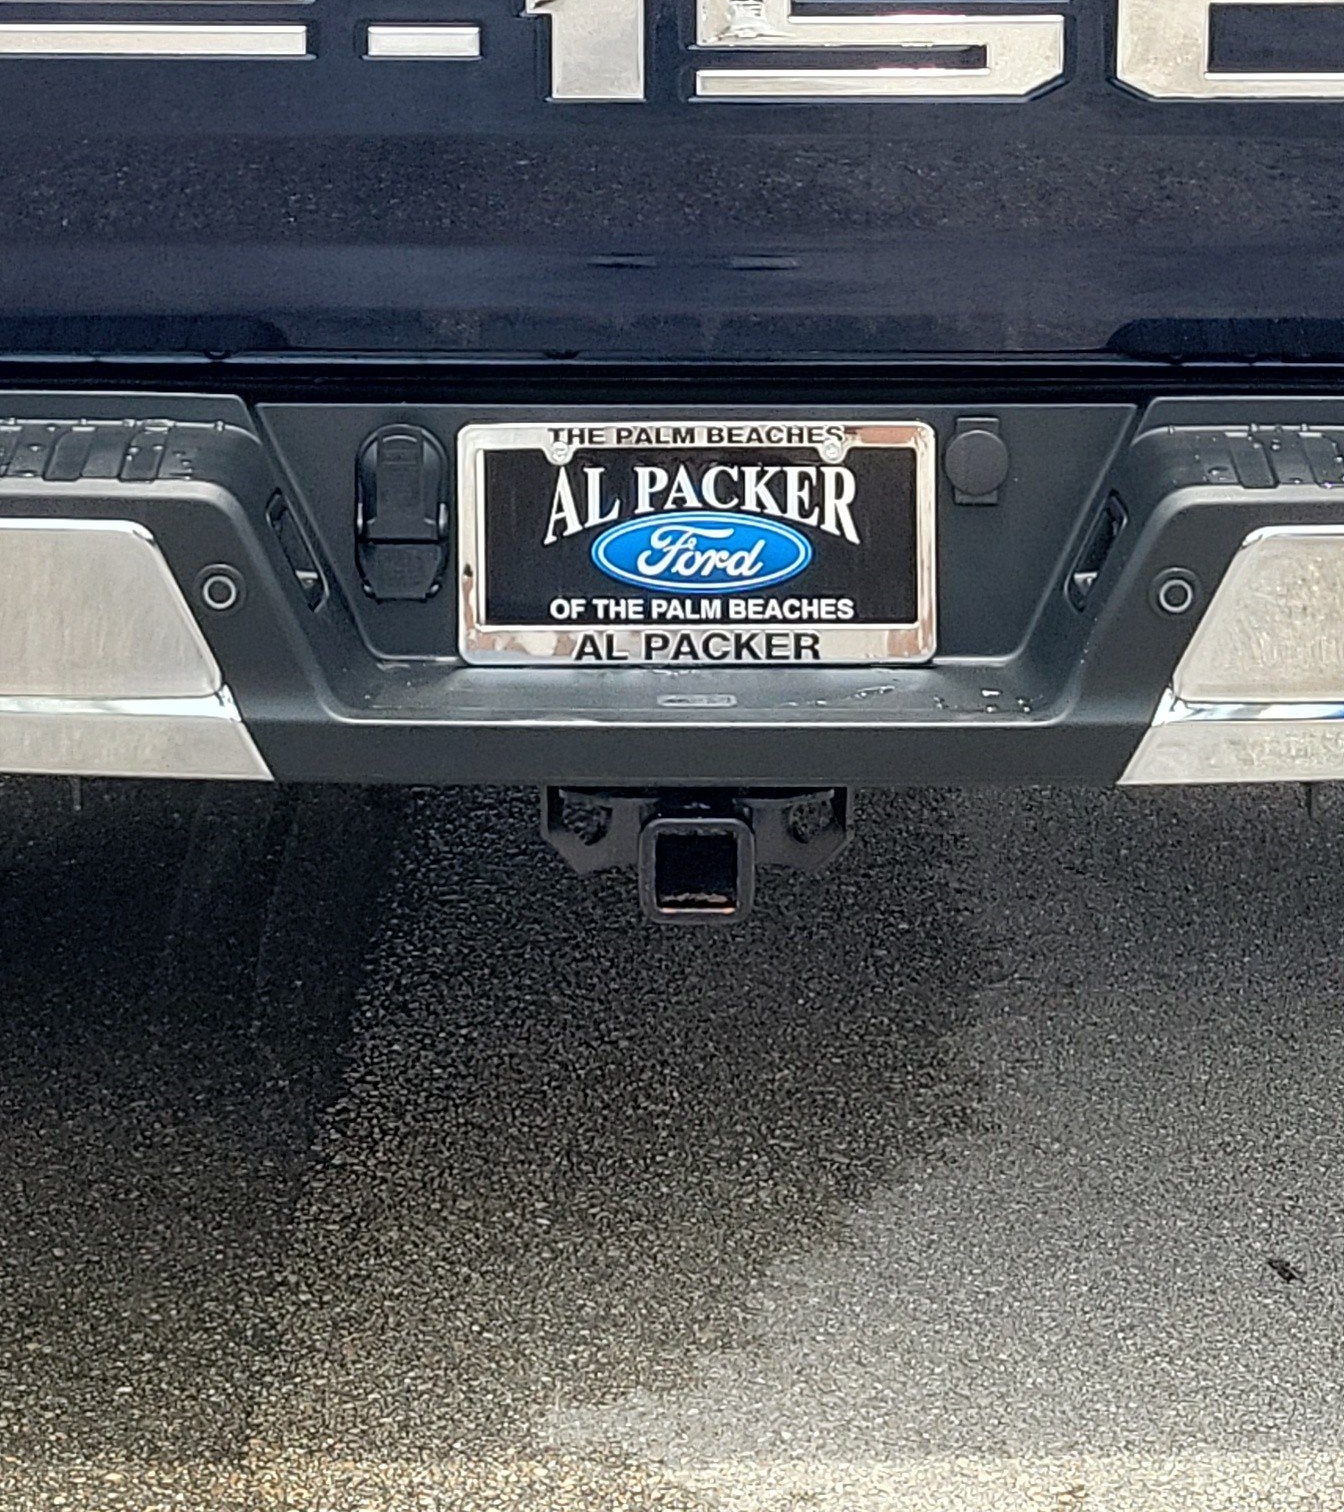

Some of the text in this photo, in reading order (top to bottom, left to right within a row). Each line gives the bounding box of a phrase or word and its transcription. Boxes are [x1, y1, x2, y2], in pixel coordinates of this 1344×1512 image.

[548, 425, 846, 445] THE PALM BEACHES
[543, 464, 861, 545] AL PACKER
[636, 524, 767, 577] Ford
[549, 597, 855, 620] OF THE PALM BEACHES
[573, 631, 821, 661] AL PACKER
